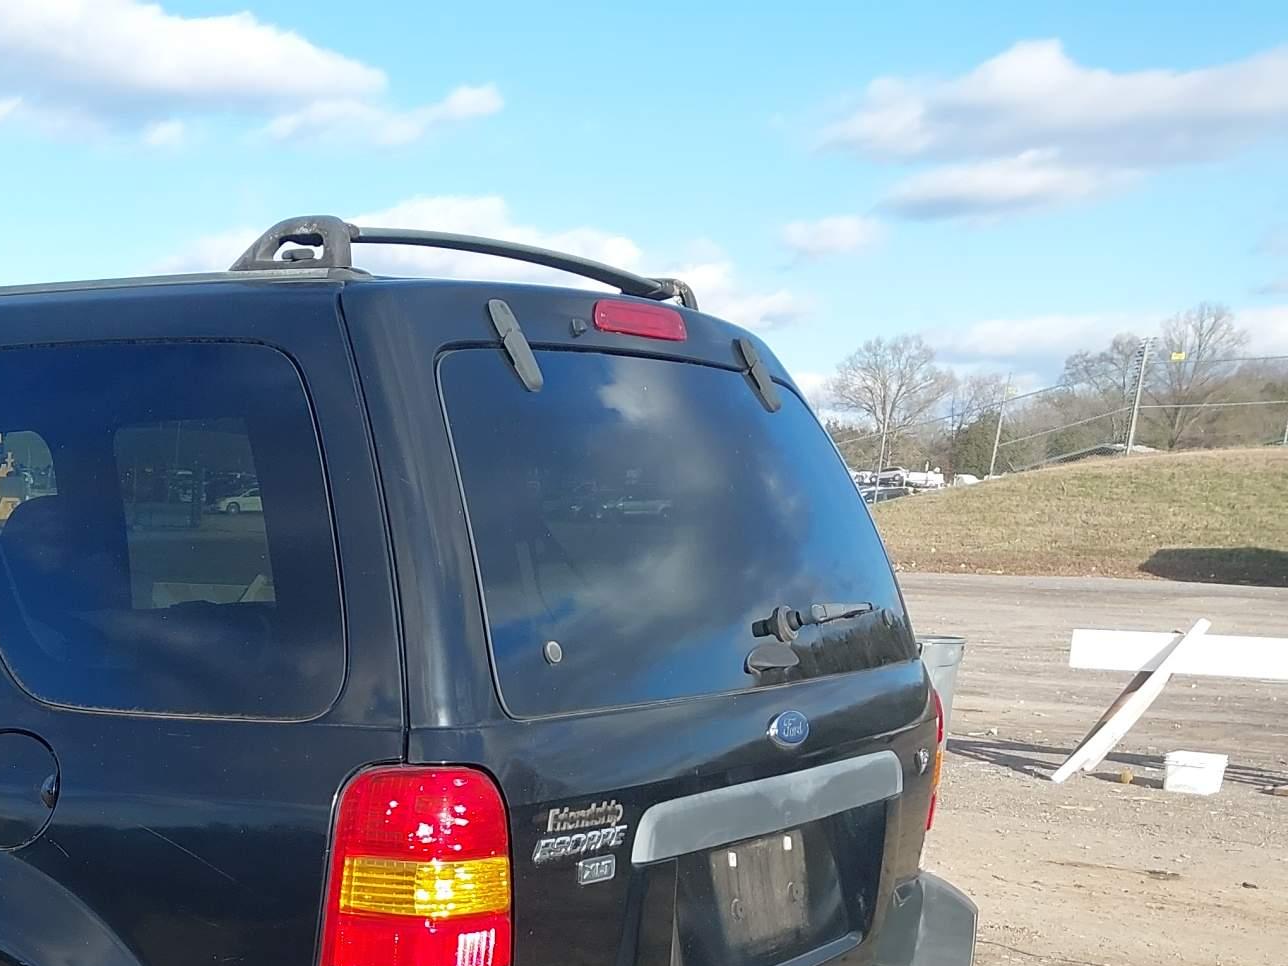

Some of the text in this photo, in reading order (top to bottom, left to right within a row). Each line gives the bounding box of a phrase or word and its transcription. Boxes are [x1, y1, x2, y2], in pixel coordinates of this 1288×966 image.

[783, 718, 802, 737] Ford
[547, 800, 624, 832] Friendship
[532, 825, 628, 863] ESCAPE
[583, 860, 613, 880] XLT
